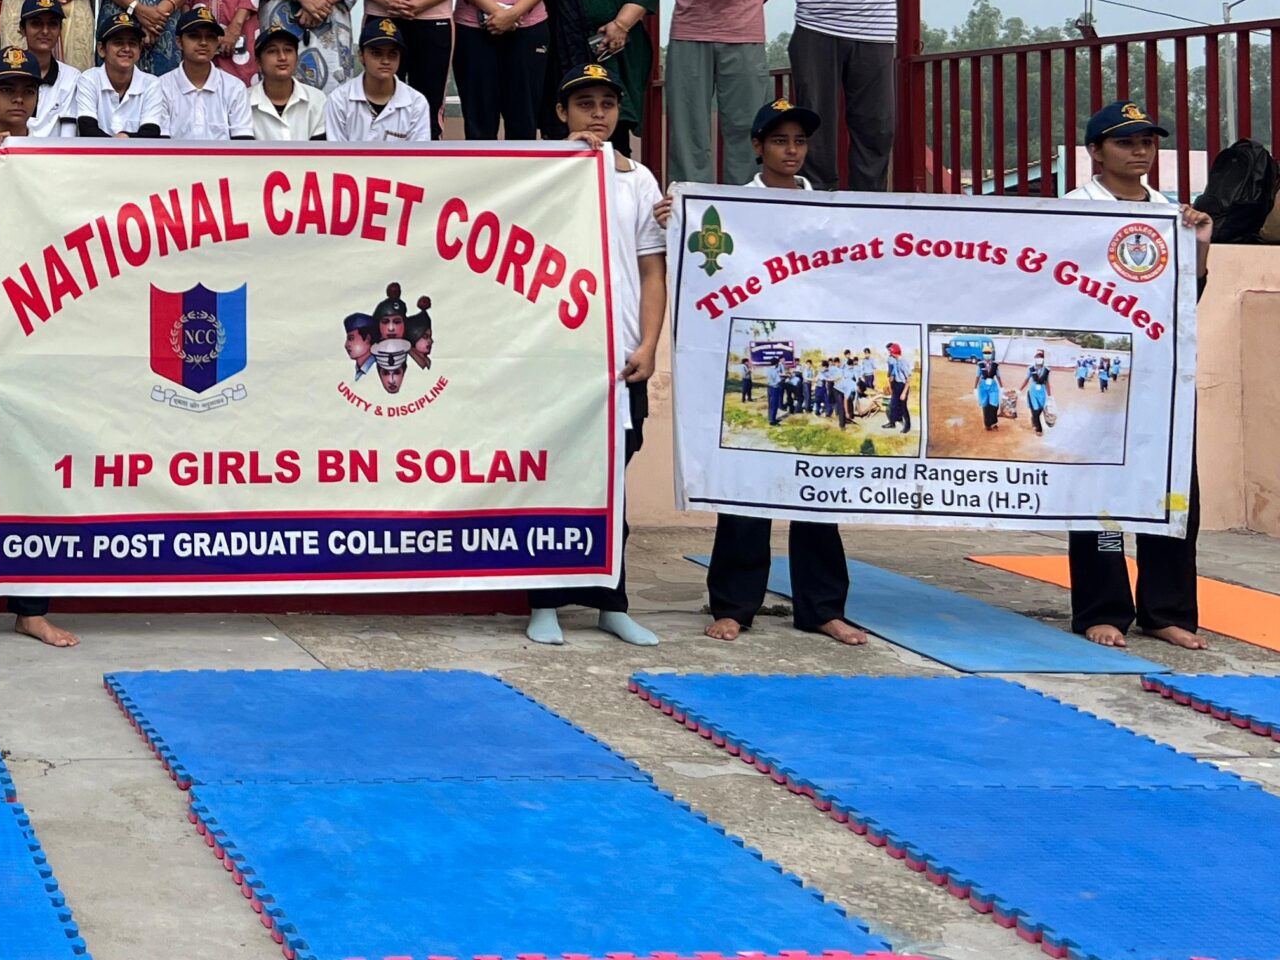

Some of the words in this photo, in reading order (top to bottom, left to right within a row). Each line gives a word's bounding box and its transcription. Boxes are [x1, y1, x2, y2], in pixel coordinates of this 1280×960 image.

[1, 177, 250, 337] NATIONAL
[262, 169, 425, 247] CADET
[435, 197, 598, 330] CORPS
[696, 276, 763, 319] The
[763, 237, 884, 284] Bharat
[893, 232, 1009, 265] Scouts
[1016, 247, 1048, 273] &
[1053, 260, 1165, 340] Guides
[184, 328, 216, 345] NCC
[337, 381, 372, 412] UNITY
[374, 405, 383, 416] &
[387, 376, 449, 417] DISCIPLINE
[54, 455, 73, 489] 1
[94, 453, 154, 488] HP
[168, 449, 302, 487] GIRLS
[317, 449, 379, 484] BN
[395, 448, 548, 484] SOLAN
[794, 460, 865, 479] Rovers
[870, 463, 907, 480] and
[913, 464, 999, 486] Rangers
[1006, 467, 1049, 486] Unit
[799, 486, 853, 504] Govt.
[859, 487, 934, 509] College
[940, 489, 981, 507] Una
[988, 491, 1041, 514] (H.P.)
[2, 534, 83, 558] GOVT.
[93, 533, 165, 559] POST
[173, 530, 320, 557] GRADUATE
[328, 529, 453, 555] COLLEGE
[461, 527, 519, 552] UNA
[526, 527, 593, 557] (H.P.)
